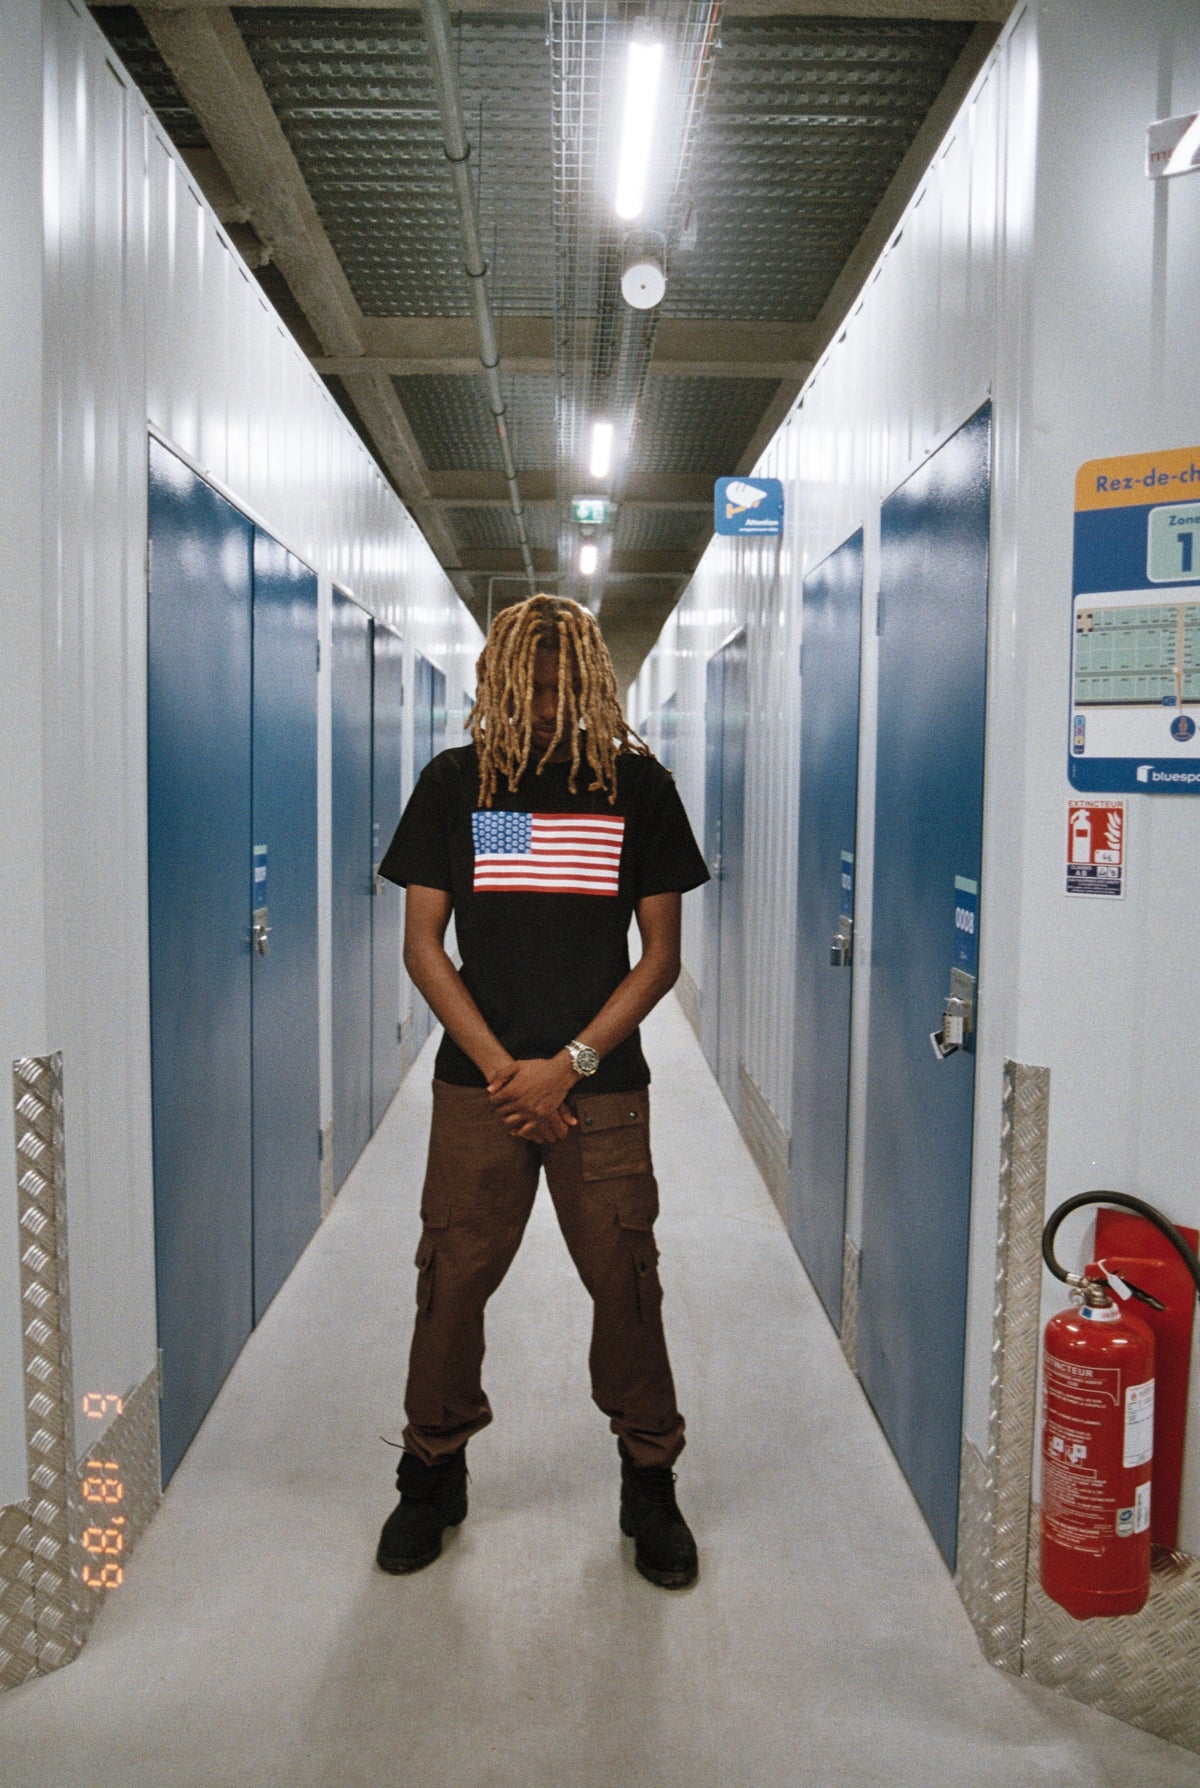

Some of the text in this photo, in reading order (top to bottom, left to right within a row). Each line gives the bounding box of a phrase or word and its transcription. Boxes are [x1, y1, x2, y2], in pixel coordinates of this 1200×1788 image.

[1096, 463, 1200, 493] Rez-de-ch
[1169, 515, 1200, 526] Zone
[1177, 532, 1193, 572] 1
[1068, 800, 1123, 809] EXTINCTEUR
